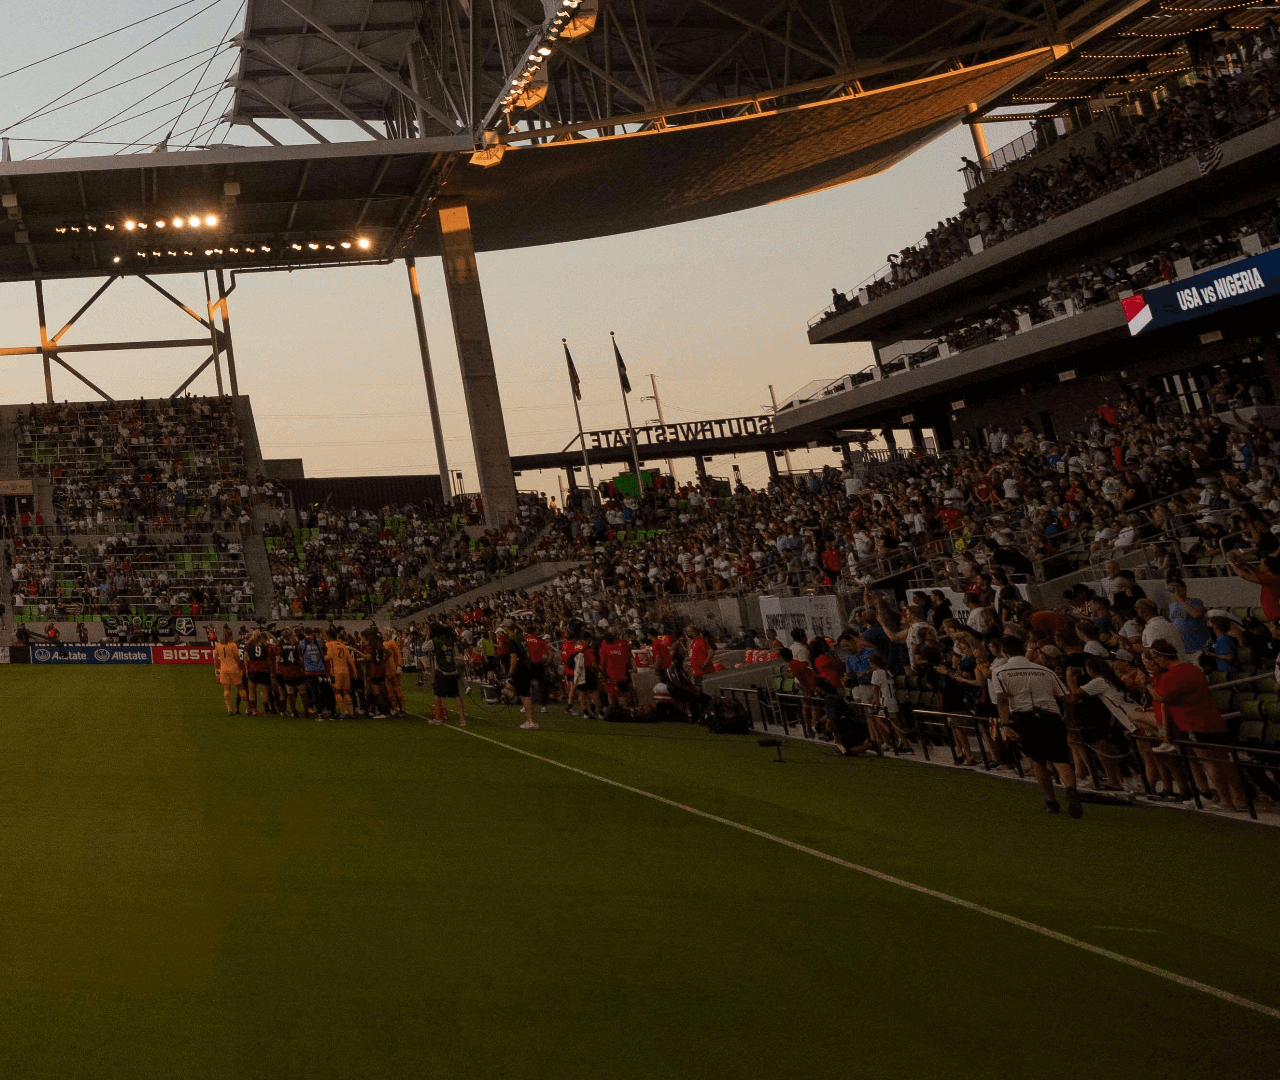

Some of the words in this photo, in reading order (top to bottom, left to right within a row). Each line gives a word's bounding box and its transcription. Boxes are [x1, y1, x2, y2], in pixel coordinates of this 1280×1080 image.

[1176, 286, 1203, 311] USA
[1200, 285, 1217, 304] vs
[1213, 267, 1265, 300] NIGERIA
[111, 651, 147, 660] Allstate
[255, 646, 262, 657] 9
